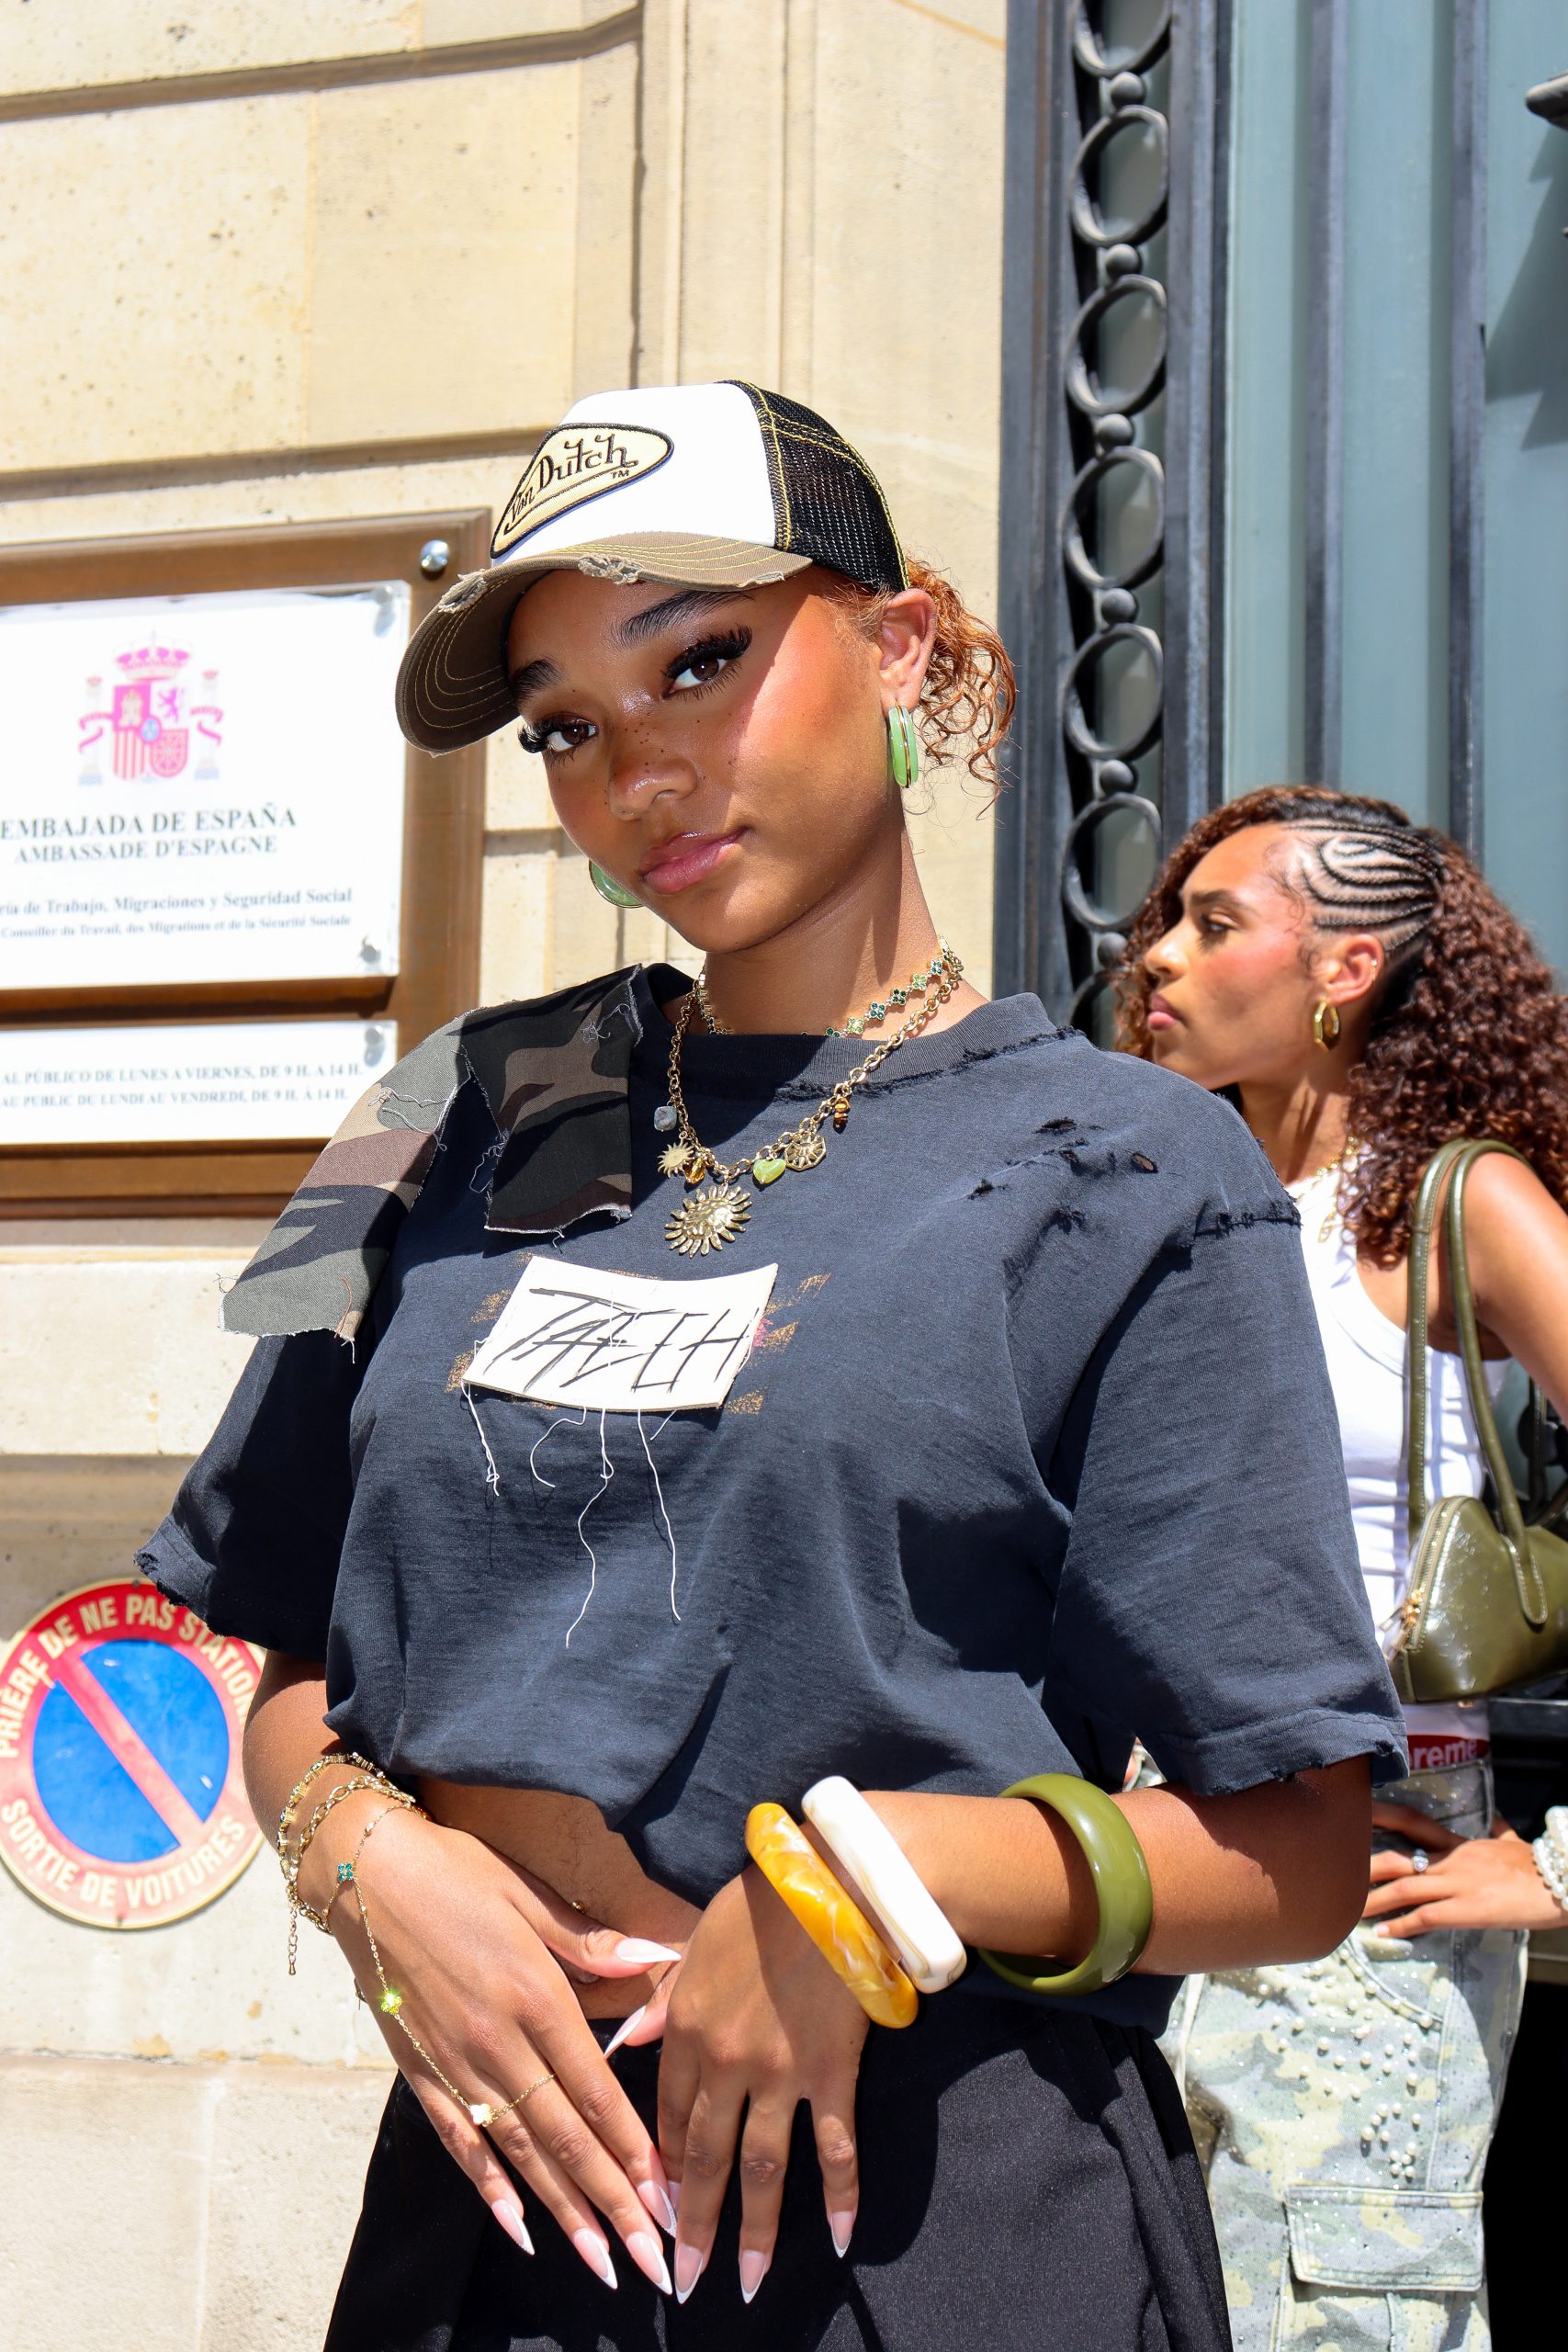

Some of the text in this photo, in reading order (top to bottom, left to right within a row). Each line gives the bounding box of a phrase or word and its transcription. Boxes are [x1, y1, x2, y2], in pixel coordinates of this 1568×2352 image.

[508, 434, 639, 523] Van Dutch
[0, 802, 296, 840] EMBAJADA DE ESPAÑA
[15, 835, 277, 864] AMBASSADE D'ESPAGNE
[23, 901, 40, 914] de
[46, 898, 108, 916] Trabajo,
[115, 894, 205, 912] Migraciones
[209, 898, 218, 911] y
[222, 889, 301, 910] Seguridad
[306, 887, 353, 904] Social
[1, 925, 56, 938] Conseiller
[60, 924, 74, 936] du
[80, 922, 121, 935] Travail,
[126, 922, 145, 933] des
[148, 919, 210, 934] Migrations
[214, 919, 226, 930] et
[228, 918, 242, 930] de
[310, 913, 351, 926] Sociale
[25, 1068, 91, 1083] PÚBLICO
[96, 1069, 115, 1081] DE
[119, 1069, 168, 1081] LUNES
[173, 1069, 182, 1080] A
[260, 1065, 279, 1078] DE
[330, 1063, 343, 1076] 14
[23, 1095, 73, 1107] PUBLIC
[100, 1093, 144, 1105] LUNDI
[251, 1090, 270, 1102] DE
[38, 1615, 79, 1659] DE
[79, 1598, 118, 1634] NE
[125, 1595, 175, 1631] PAS
[1, 1798, 246, 1909] SORTIE DE VOITURES
